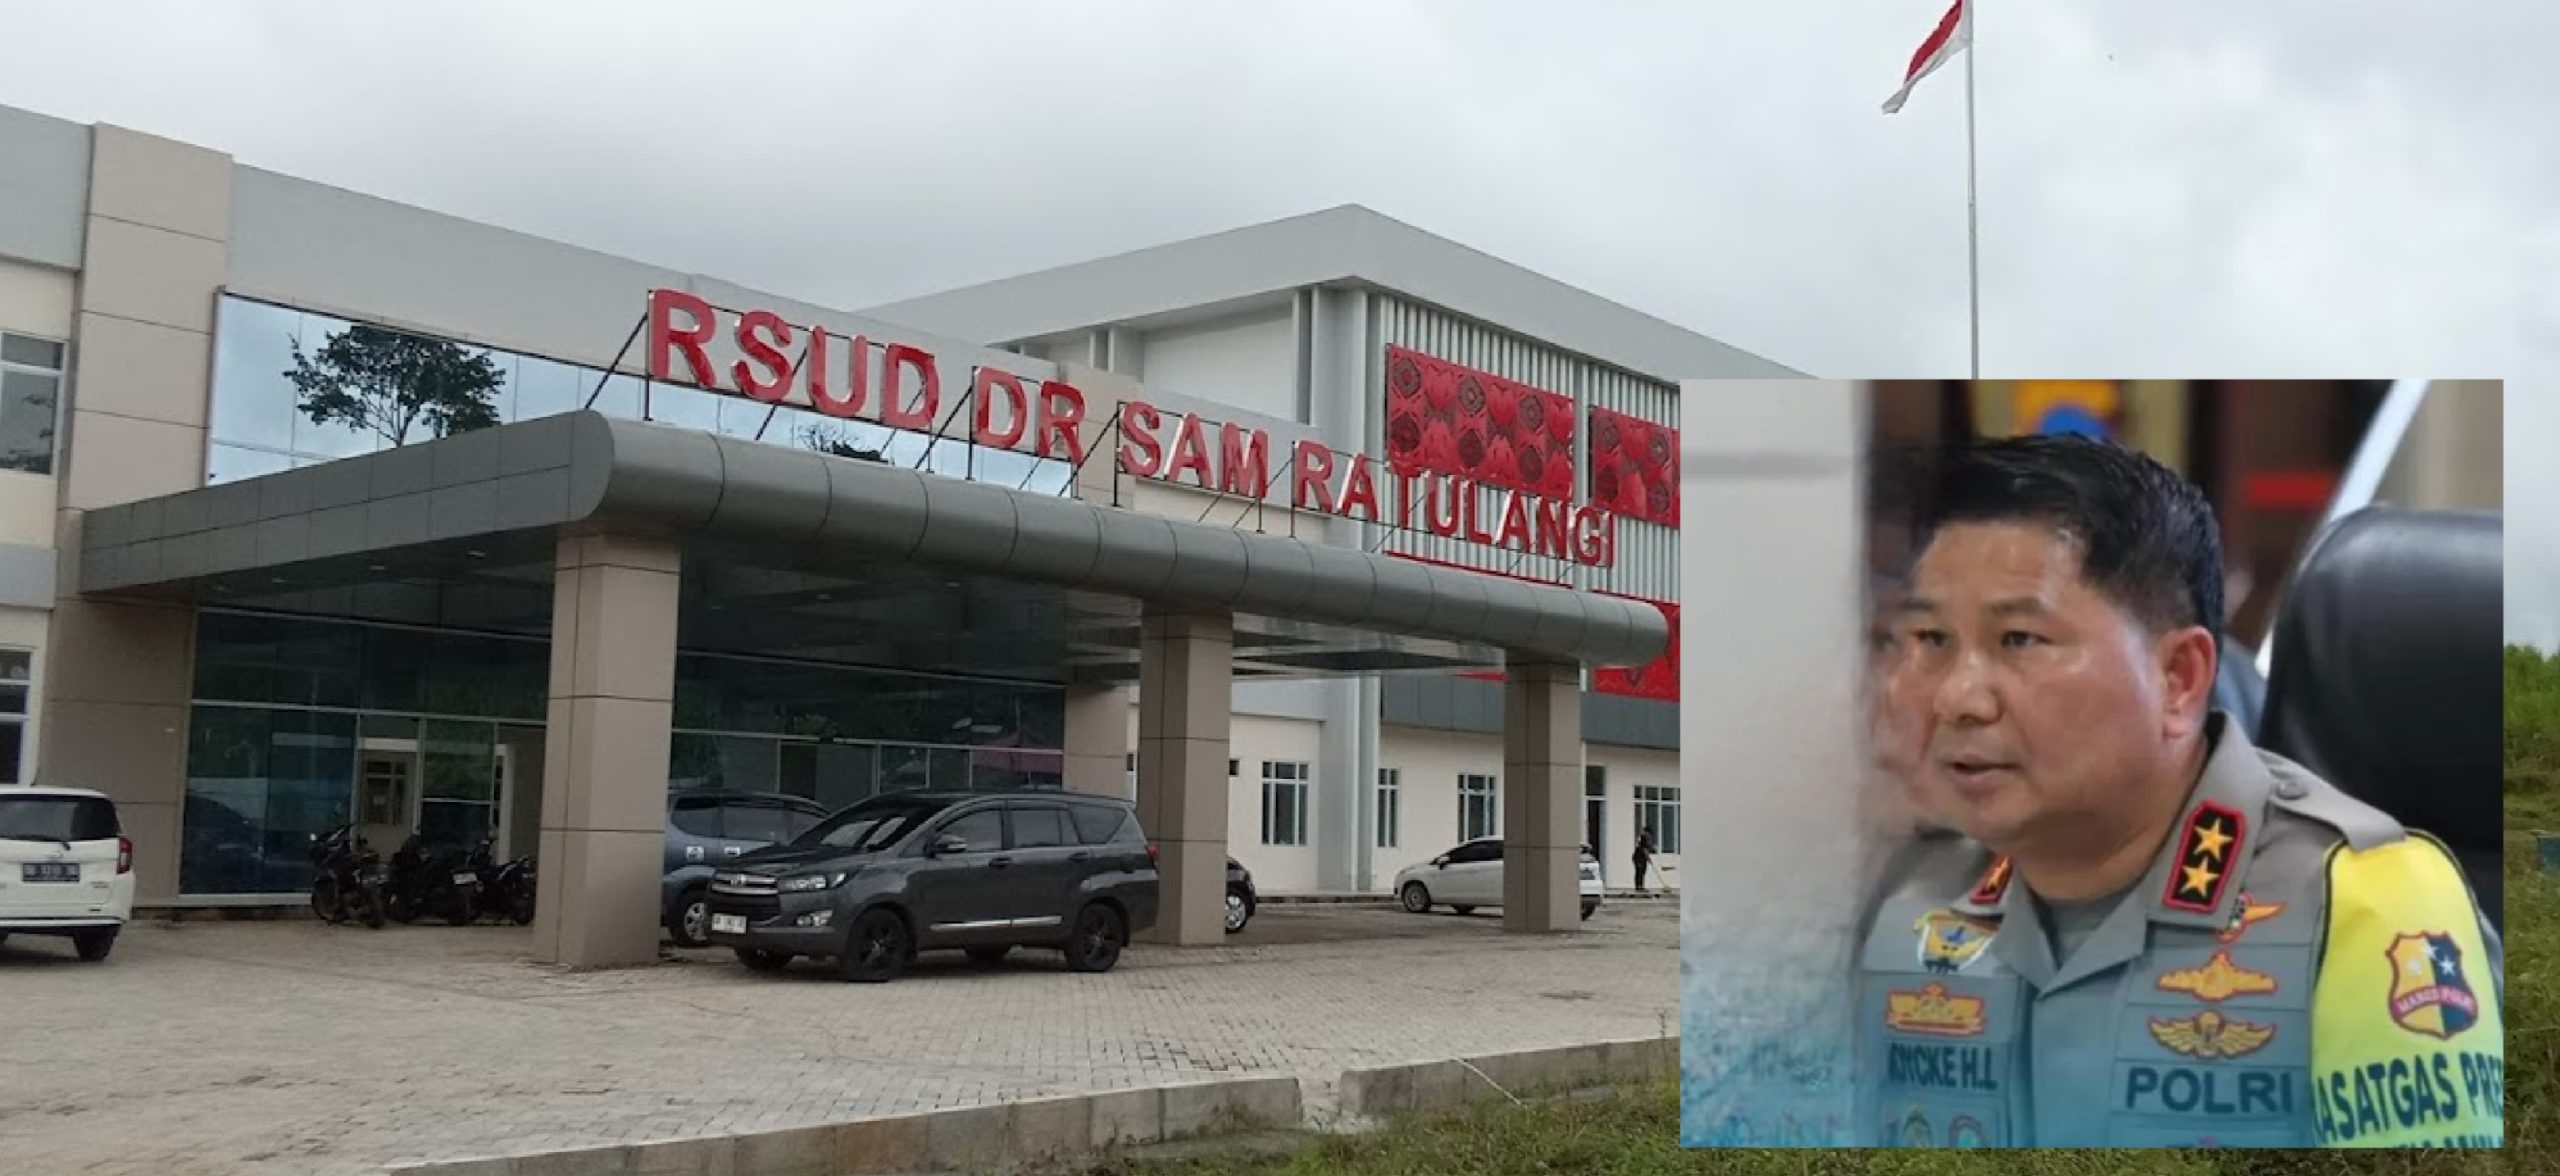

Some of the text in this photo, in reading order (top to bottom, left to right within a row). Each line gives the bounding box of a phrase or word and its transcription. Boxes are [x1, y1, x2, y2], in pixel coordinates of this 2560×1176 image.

[649, 288, 939, 429] RSUD
[973, 366, 1086, 466] DR
[1117, 401, 1270, 500] SAM
[2126, 1066, 2293, 1113] POLRI
